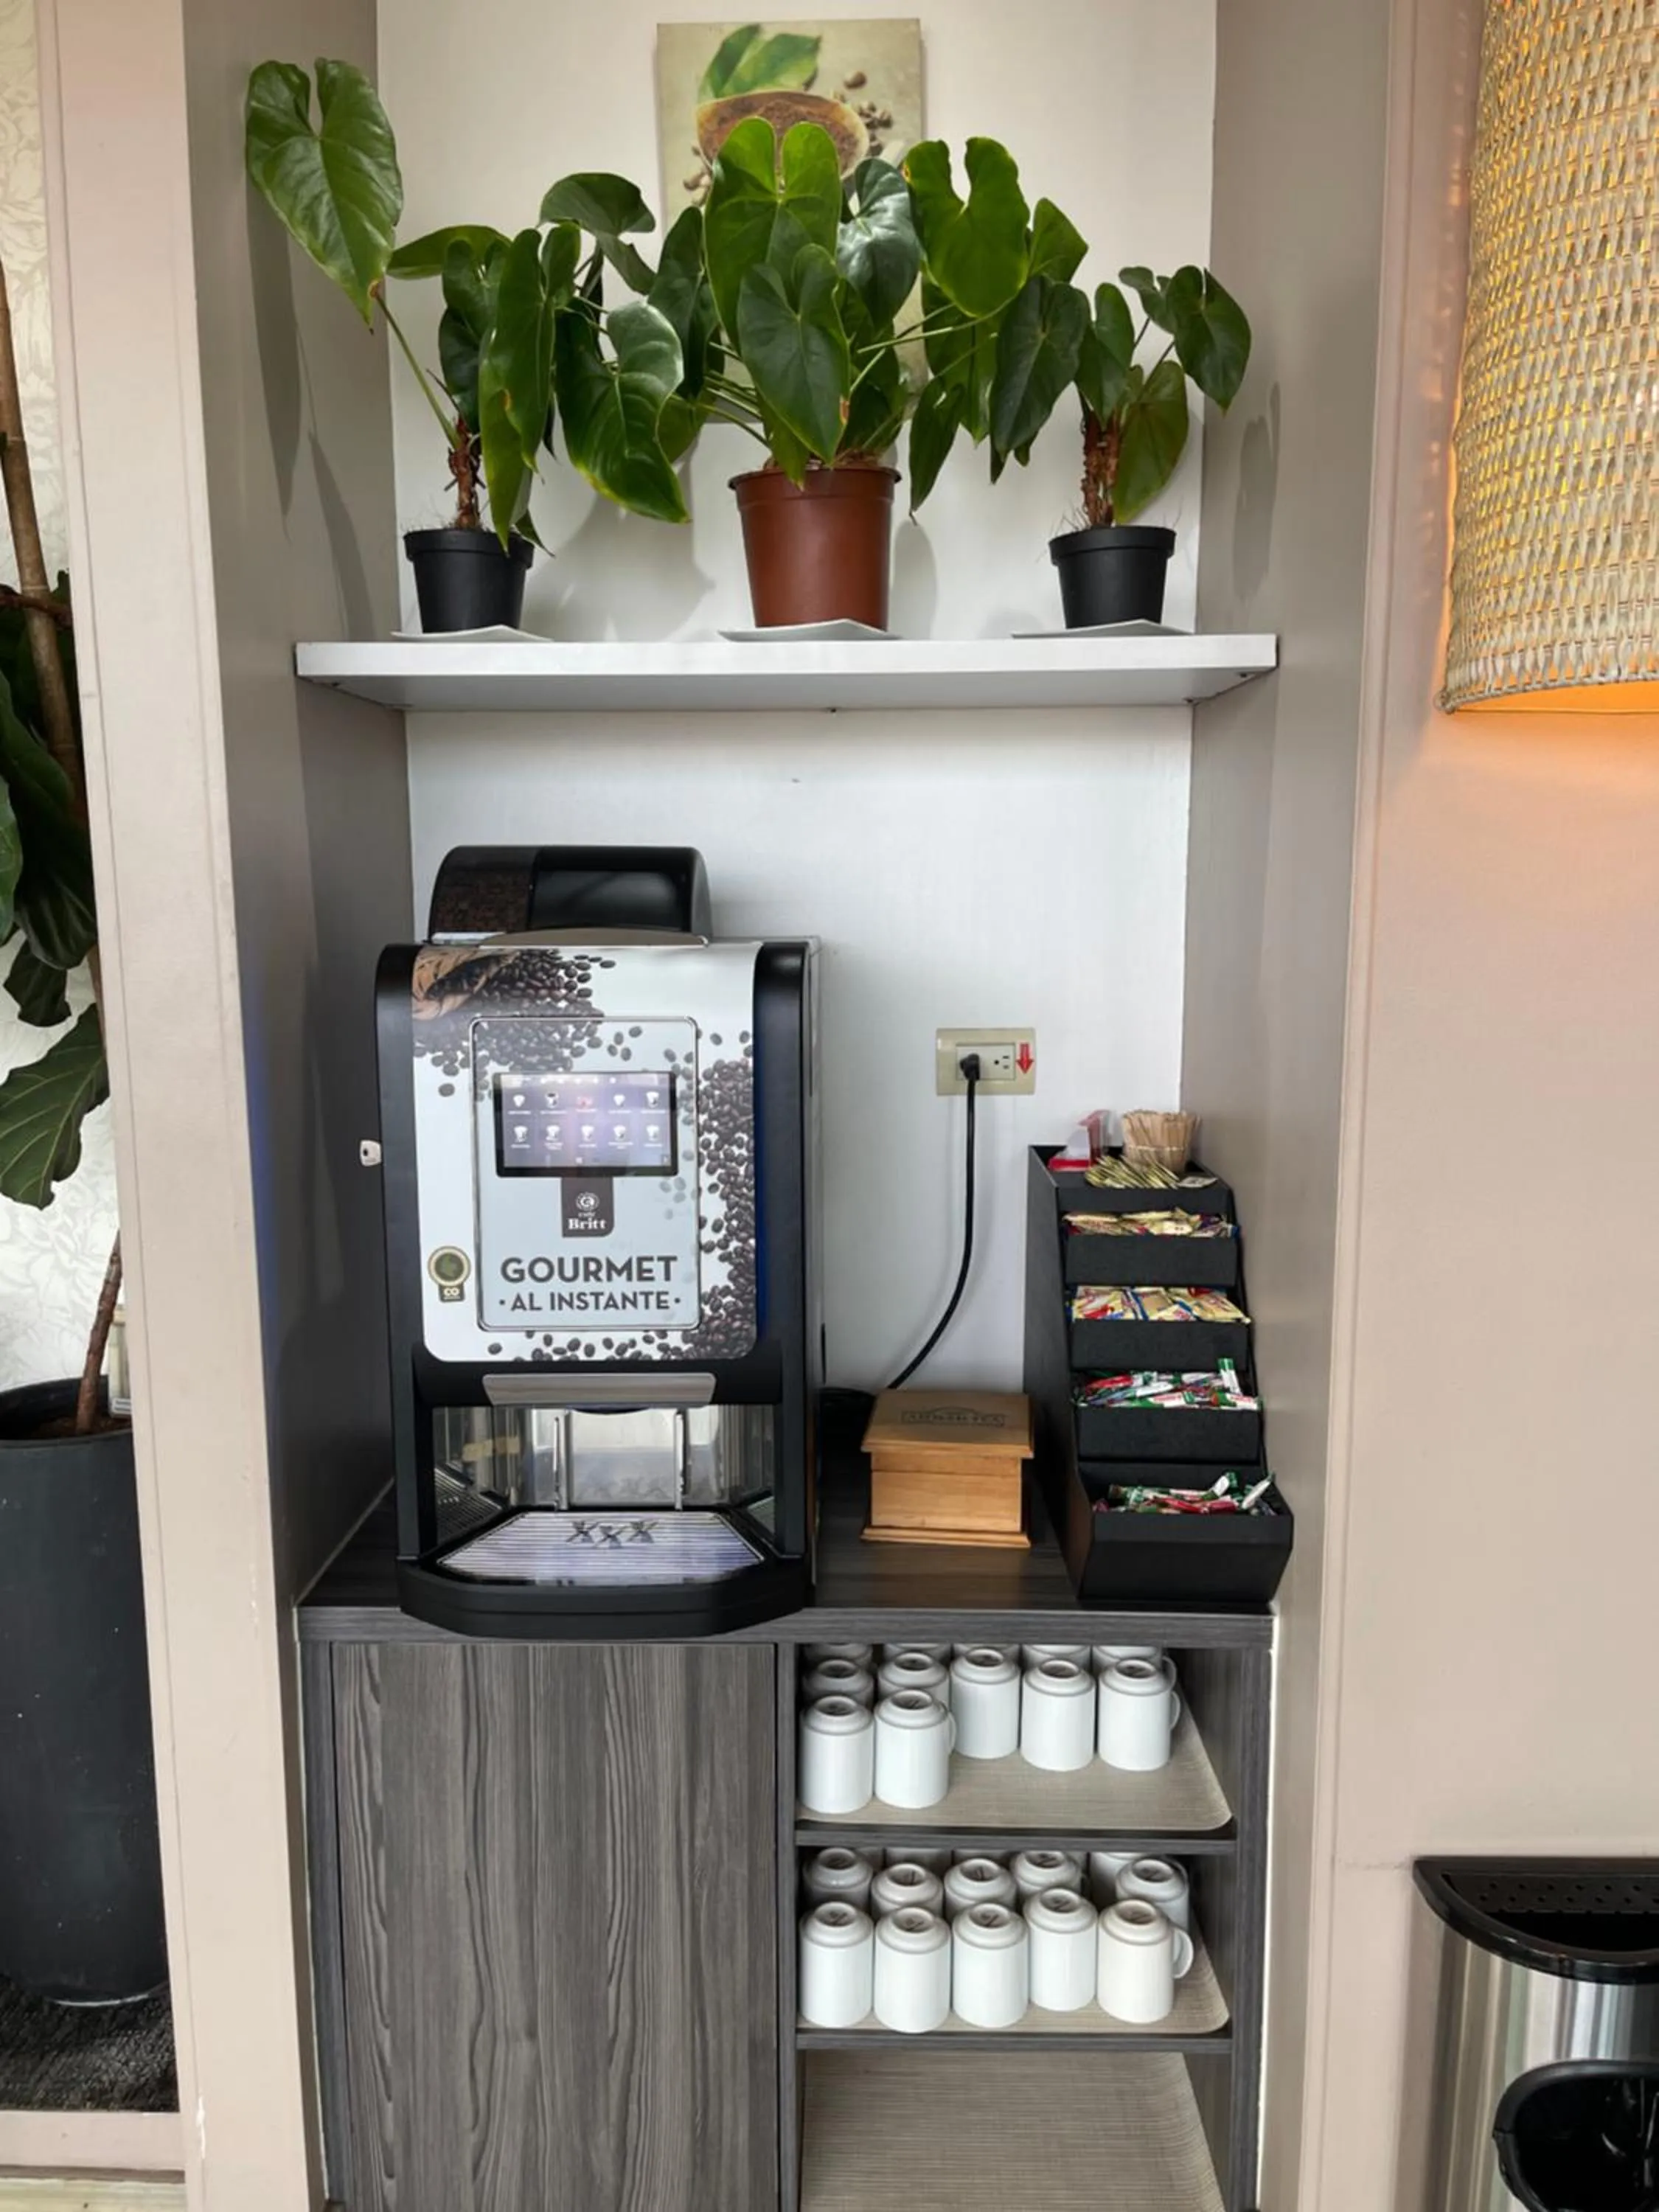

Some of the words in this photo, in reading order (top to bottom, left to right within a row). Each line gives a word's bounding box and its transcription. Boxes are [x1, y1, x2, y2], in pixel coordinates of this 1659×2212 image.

[568, 1218, 606, 1230] Britt
[500, 1256, 678, 1283] GOURMET
[510, 1292, 542, 1311] AL
[550, 1291, 670, 1311] INSTANTE
